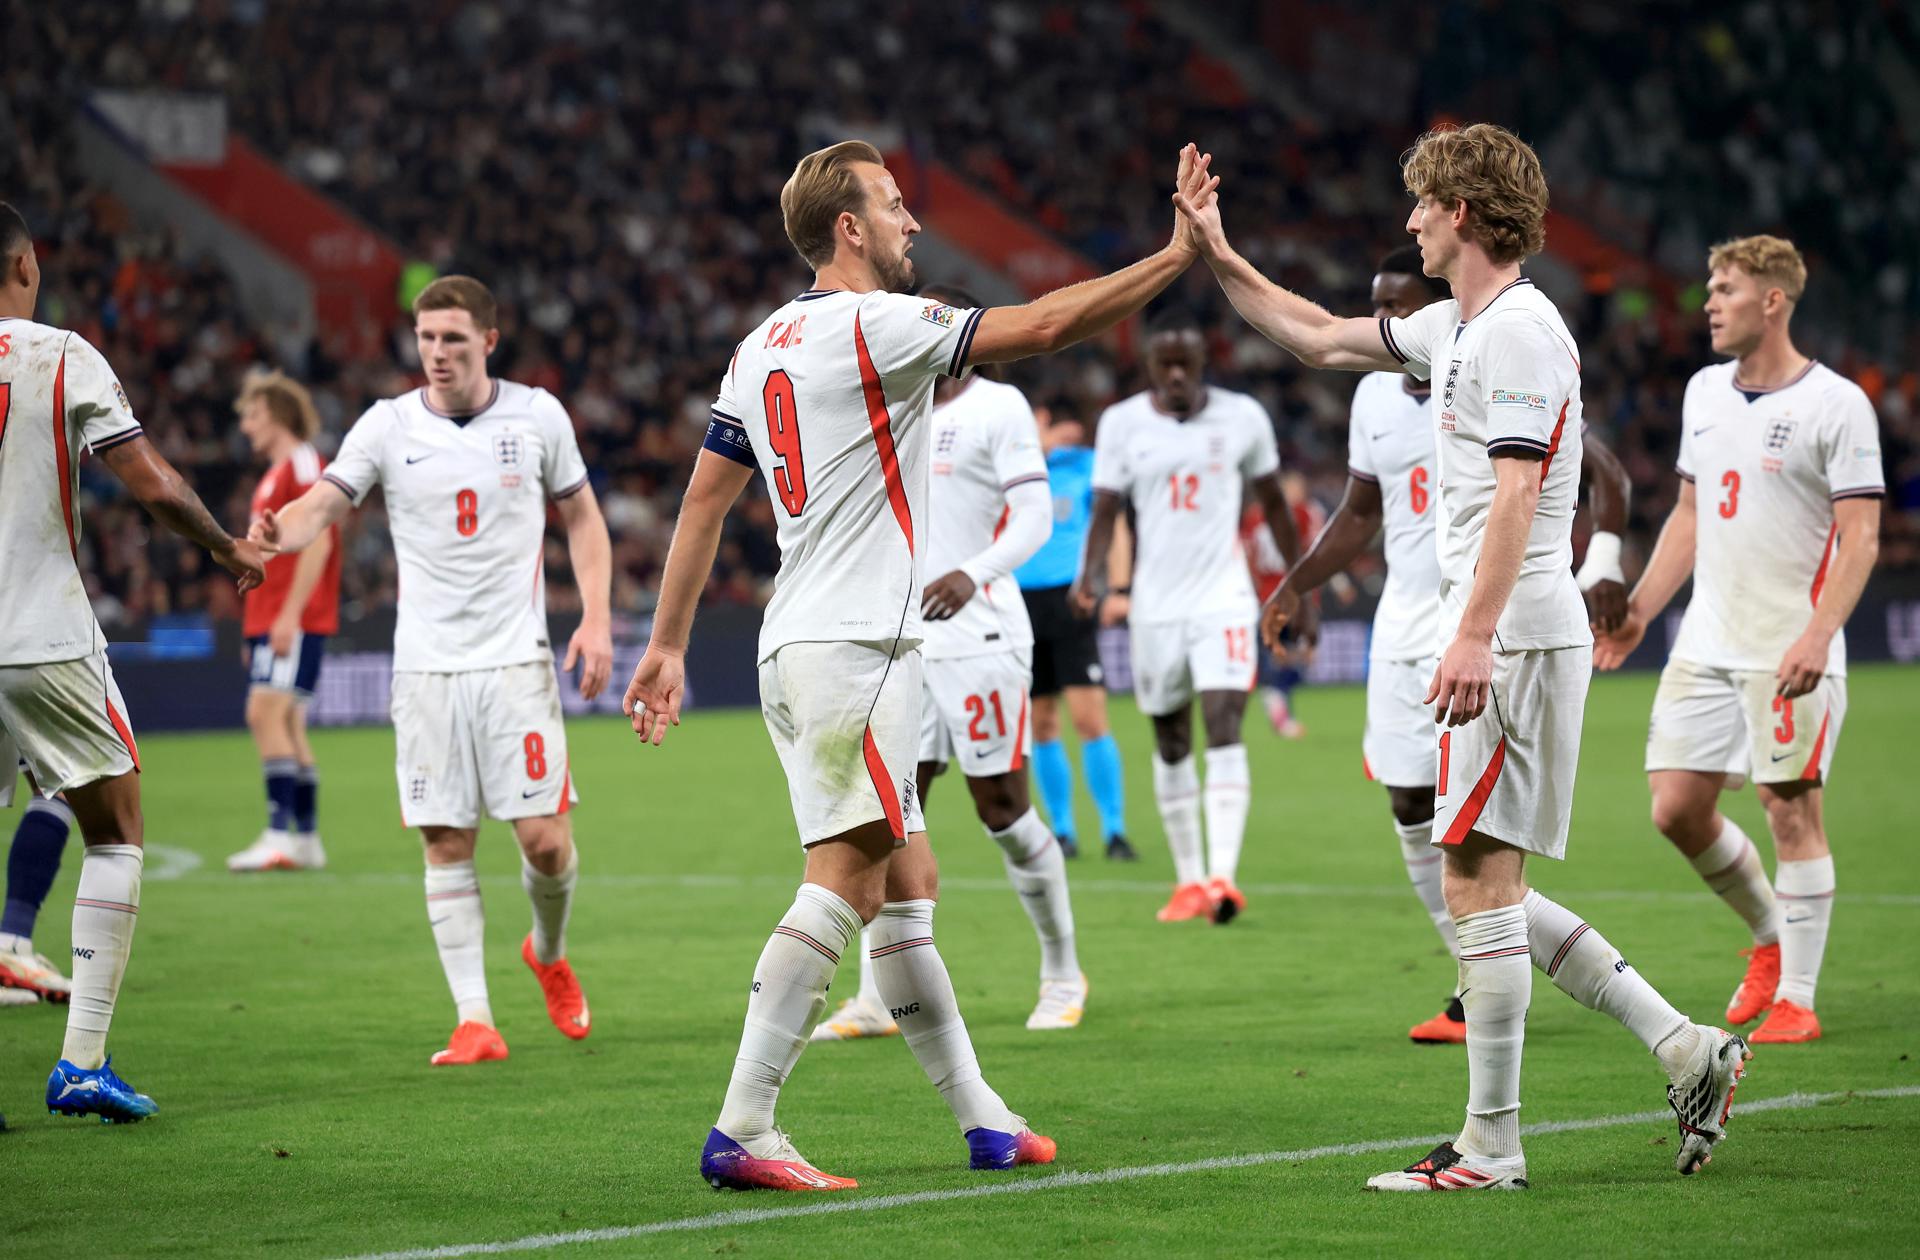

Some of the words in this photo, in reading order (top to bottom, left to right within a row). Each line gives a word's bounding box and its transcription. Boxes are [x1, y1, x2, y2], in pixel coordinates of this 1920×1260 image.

[1491, 394, 1547, 405] FOUNDATION
[763, 368, 808, 518] 9
[456, 488, 478, 537] 8
[1169, 474, 1200, 512] 12
[1410, 466, 1428, 515] 6
[1719, 470, 1741, 519] 3
[1224, 627, 1250, 662] 12
[964, 690, 1007, 741] 21
[1772, 694, 1795, 744] 3
[524, 732, 547, 781] 8
[1436, 731, 1451, 797] 1
[890, 1002, 920, 1020] ENG
